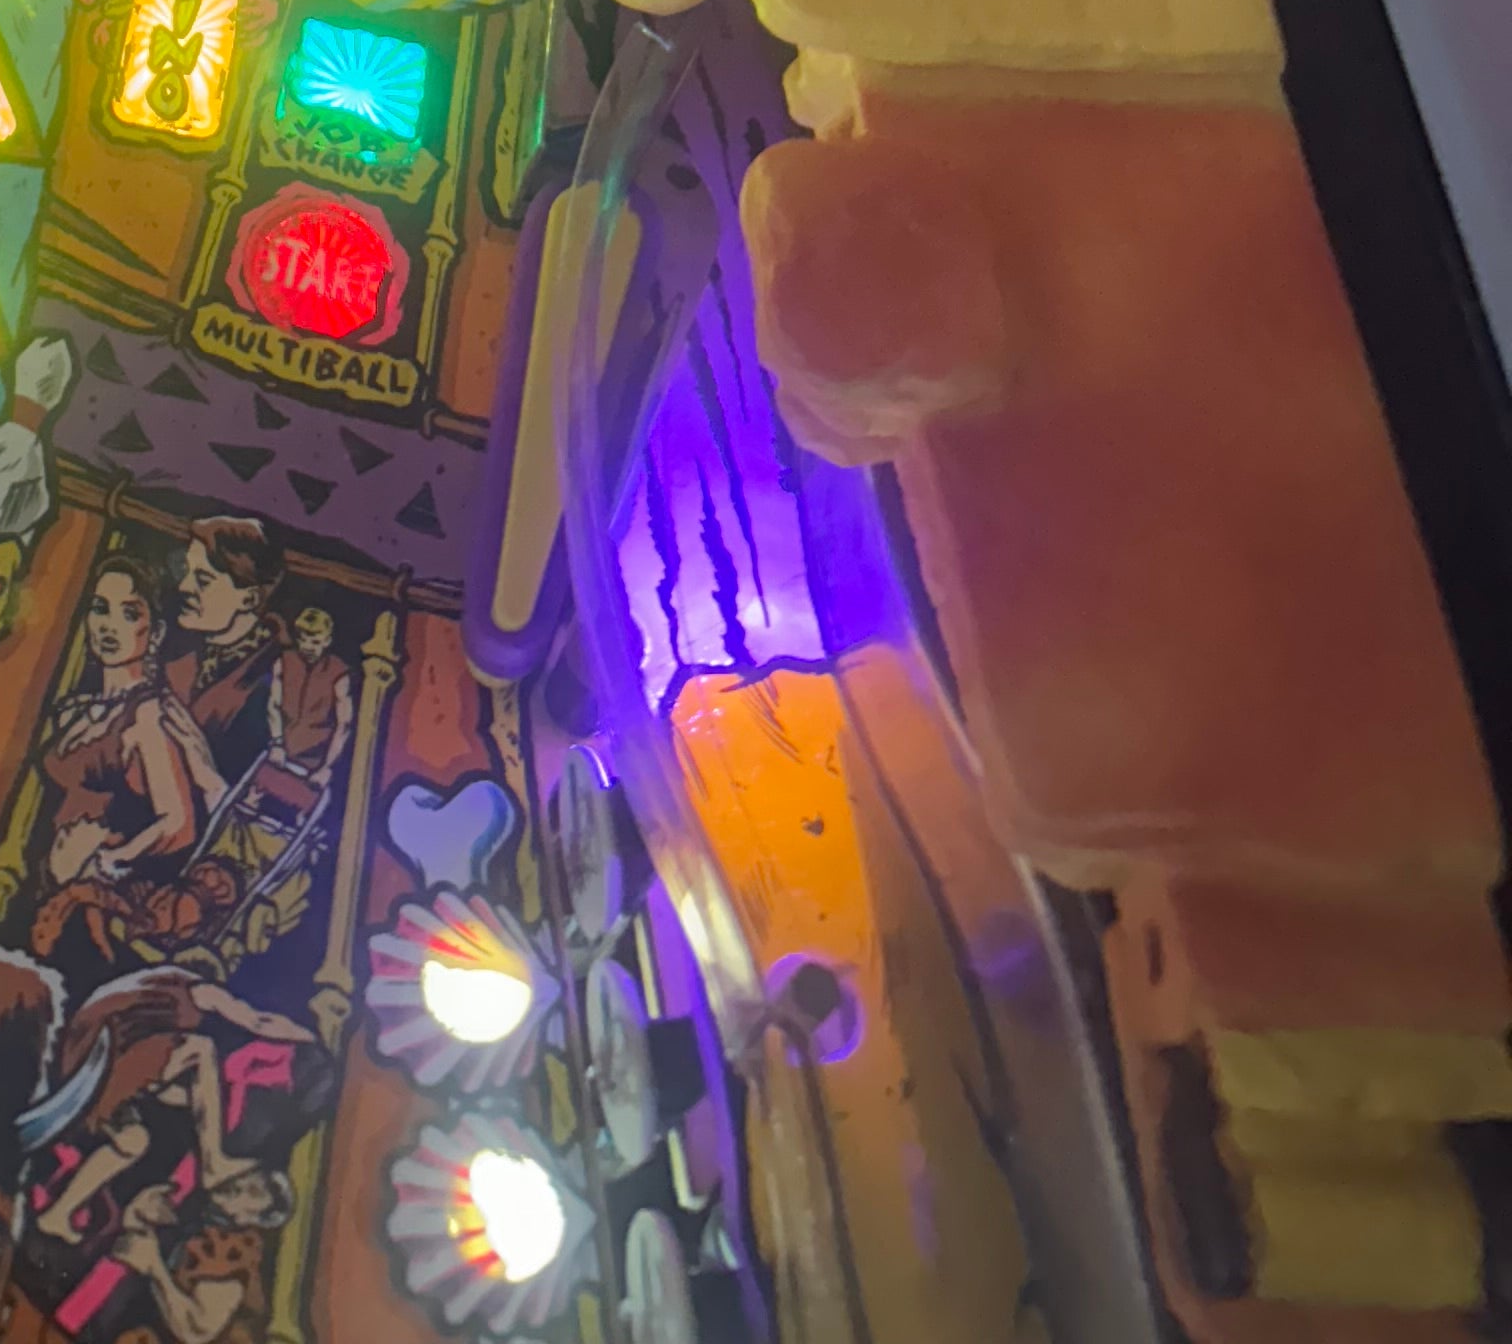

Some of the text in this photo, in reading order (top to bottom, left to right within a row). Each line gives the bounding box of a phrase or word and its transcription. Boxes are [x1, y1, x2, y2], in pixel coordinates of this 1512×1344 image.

[273, 137, 415, 192] CHANGE
[253, 236, 377, 305] START
[202, 316, 411, 395] MULTIBALL
